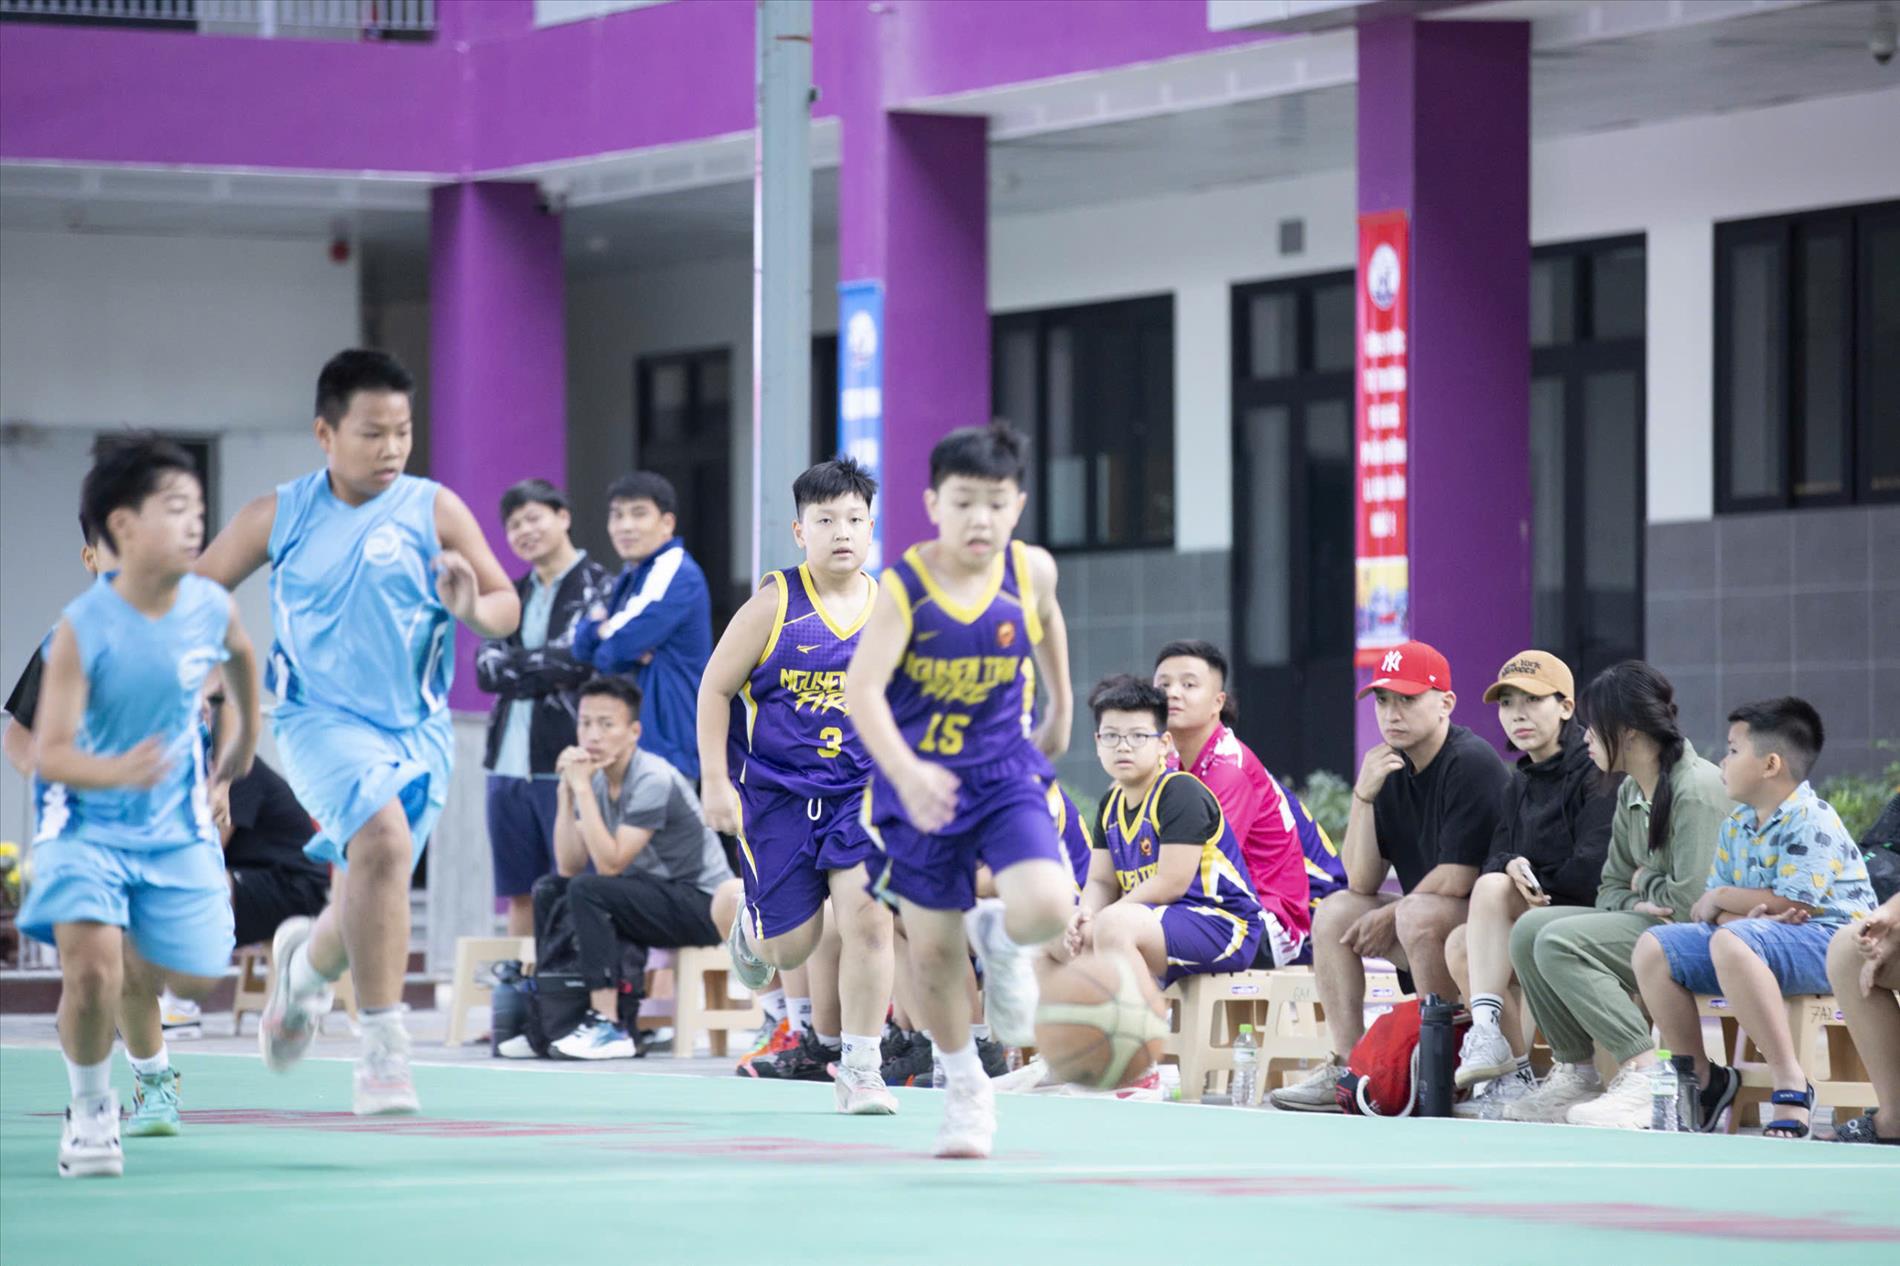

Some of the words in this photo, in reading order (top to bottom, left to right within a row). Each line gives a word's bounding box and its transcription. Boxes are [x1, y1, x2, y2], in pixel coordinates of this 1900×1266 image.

[1381, 650, 1403, 672] NY
[795, 690, 849, 718] FIR
[817, 726, 843, 758] 3
[918, 712, 972, 756] 15
